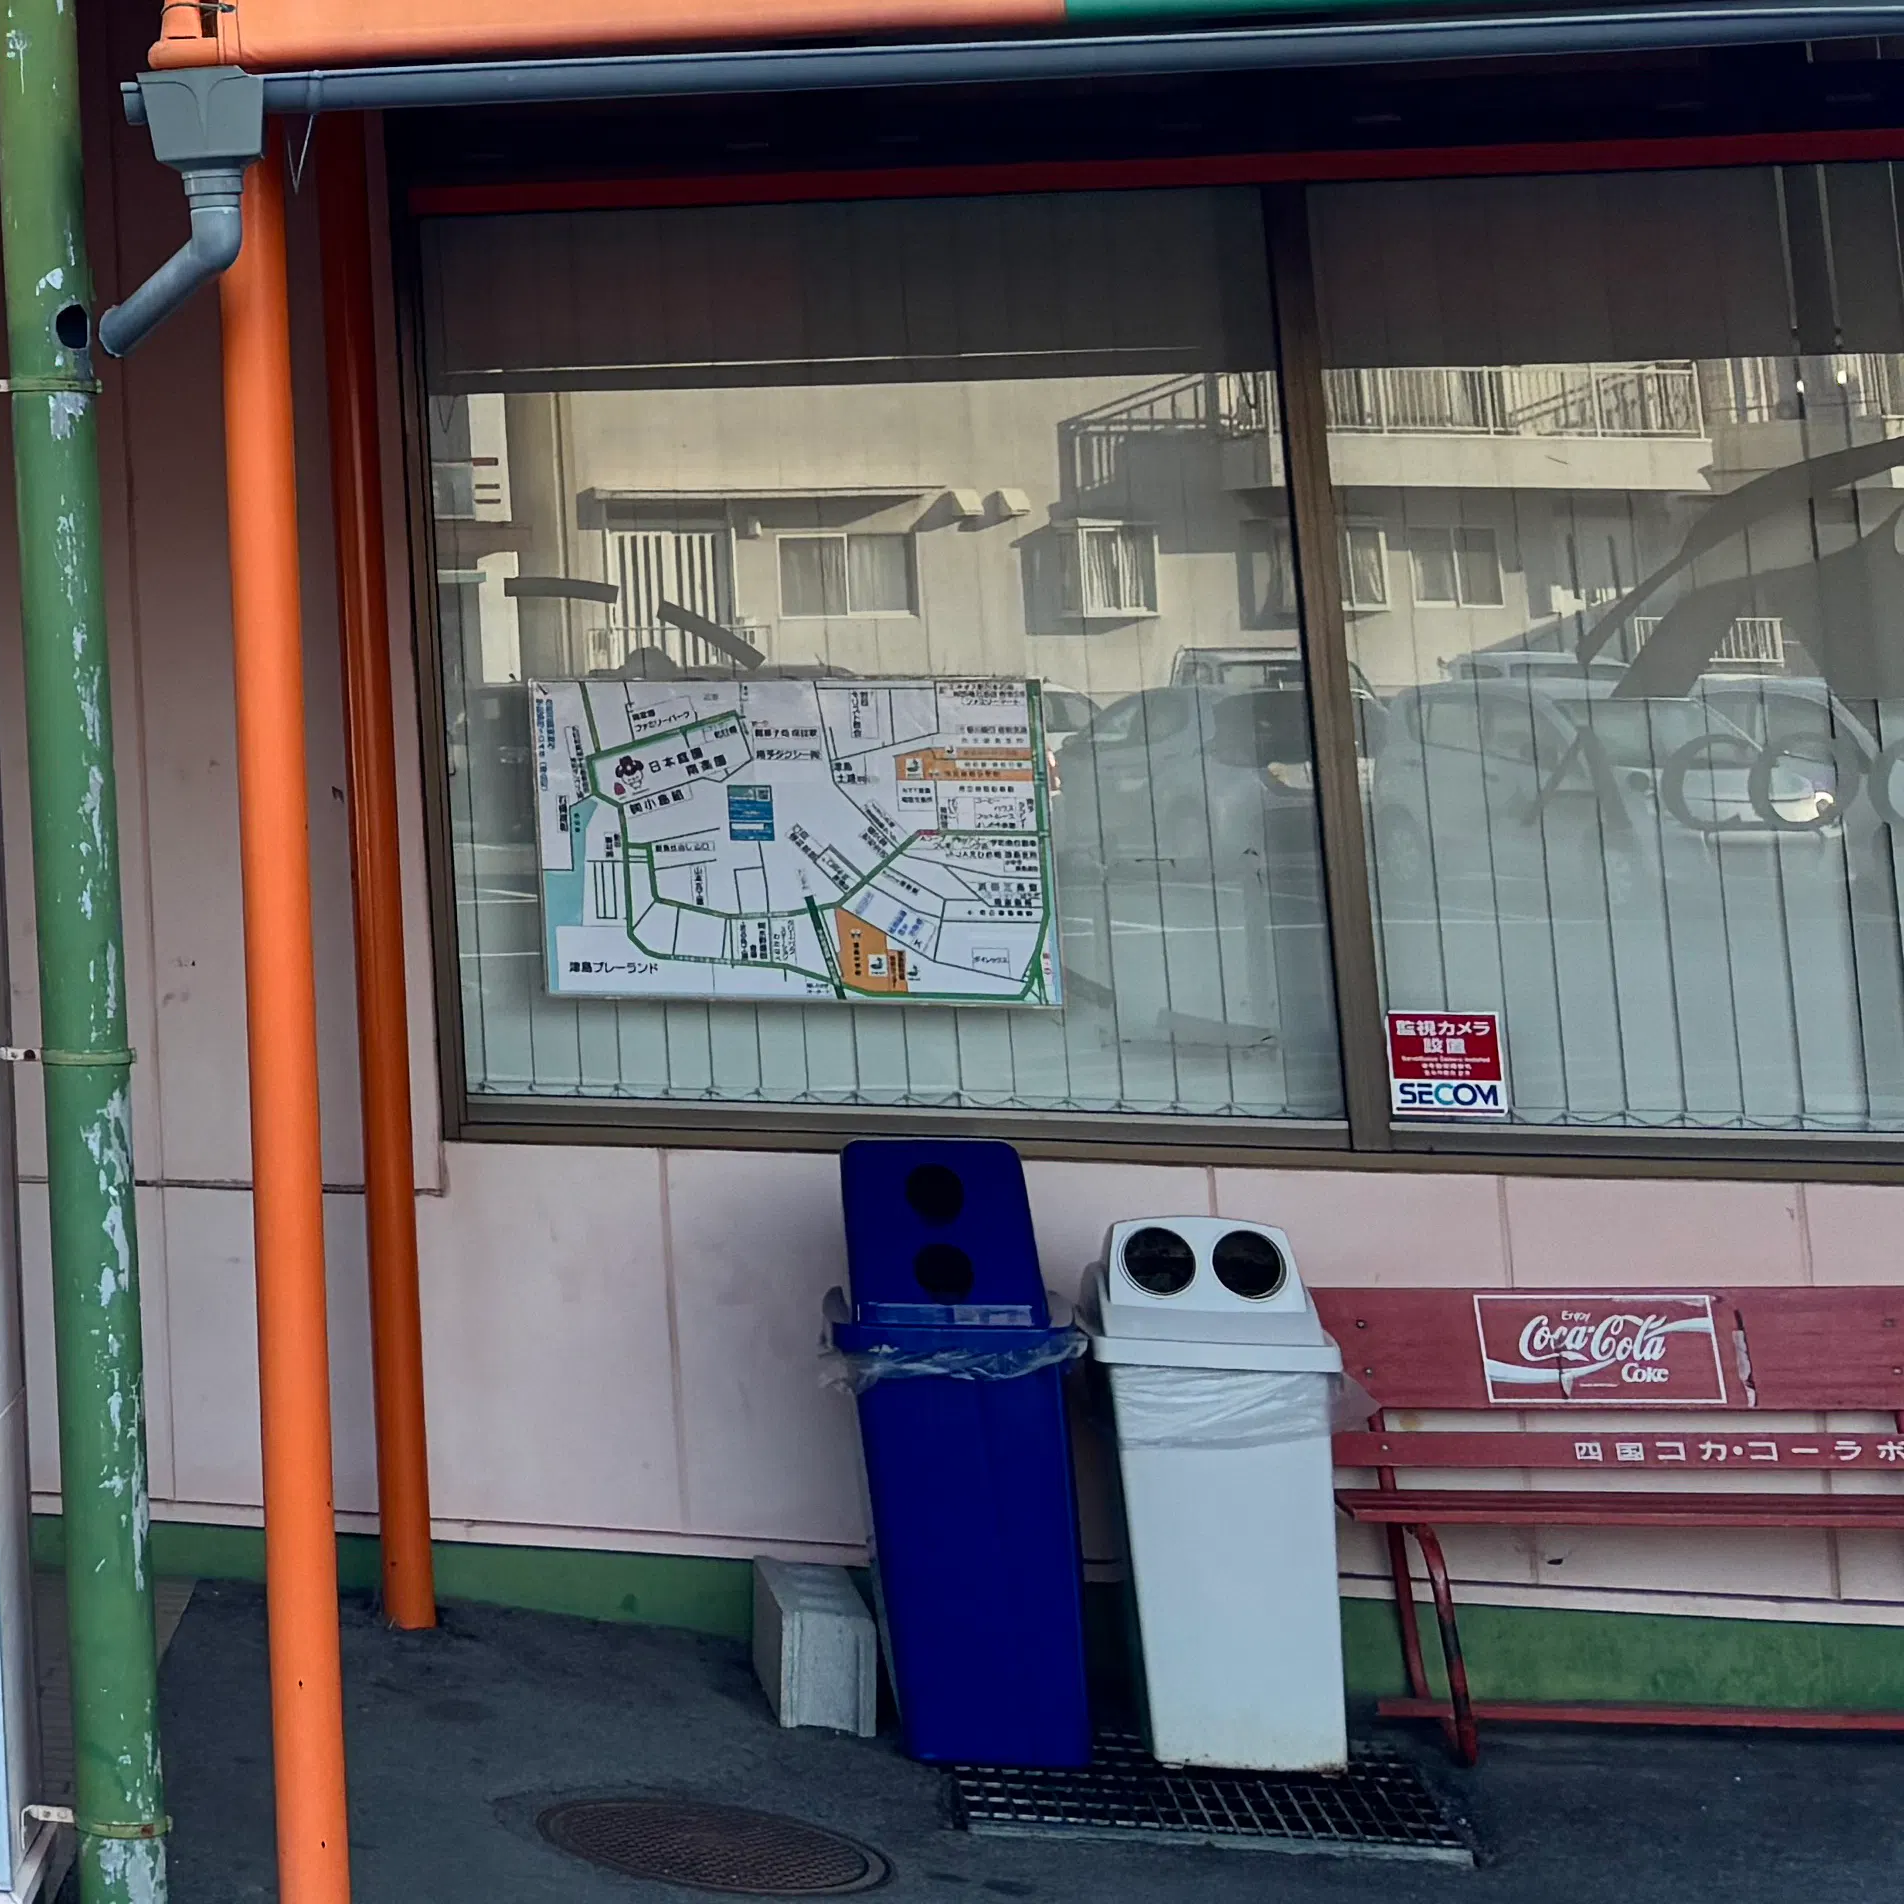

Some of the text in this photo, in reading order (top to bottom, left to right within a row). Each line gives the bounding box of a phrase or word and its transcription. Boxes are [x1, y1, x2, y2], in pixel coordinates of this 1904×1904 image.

[568, 961, 659, 975] 津島プレーランド
[1395, 1020, 1491, 1037] 監視カメラ
[1399, 1082, 1499, 1107] SECOM
[1519, 1312, 1669, 1363] Coca-Cola
[1620, 1362, 1670, 1384] Coke
